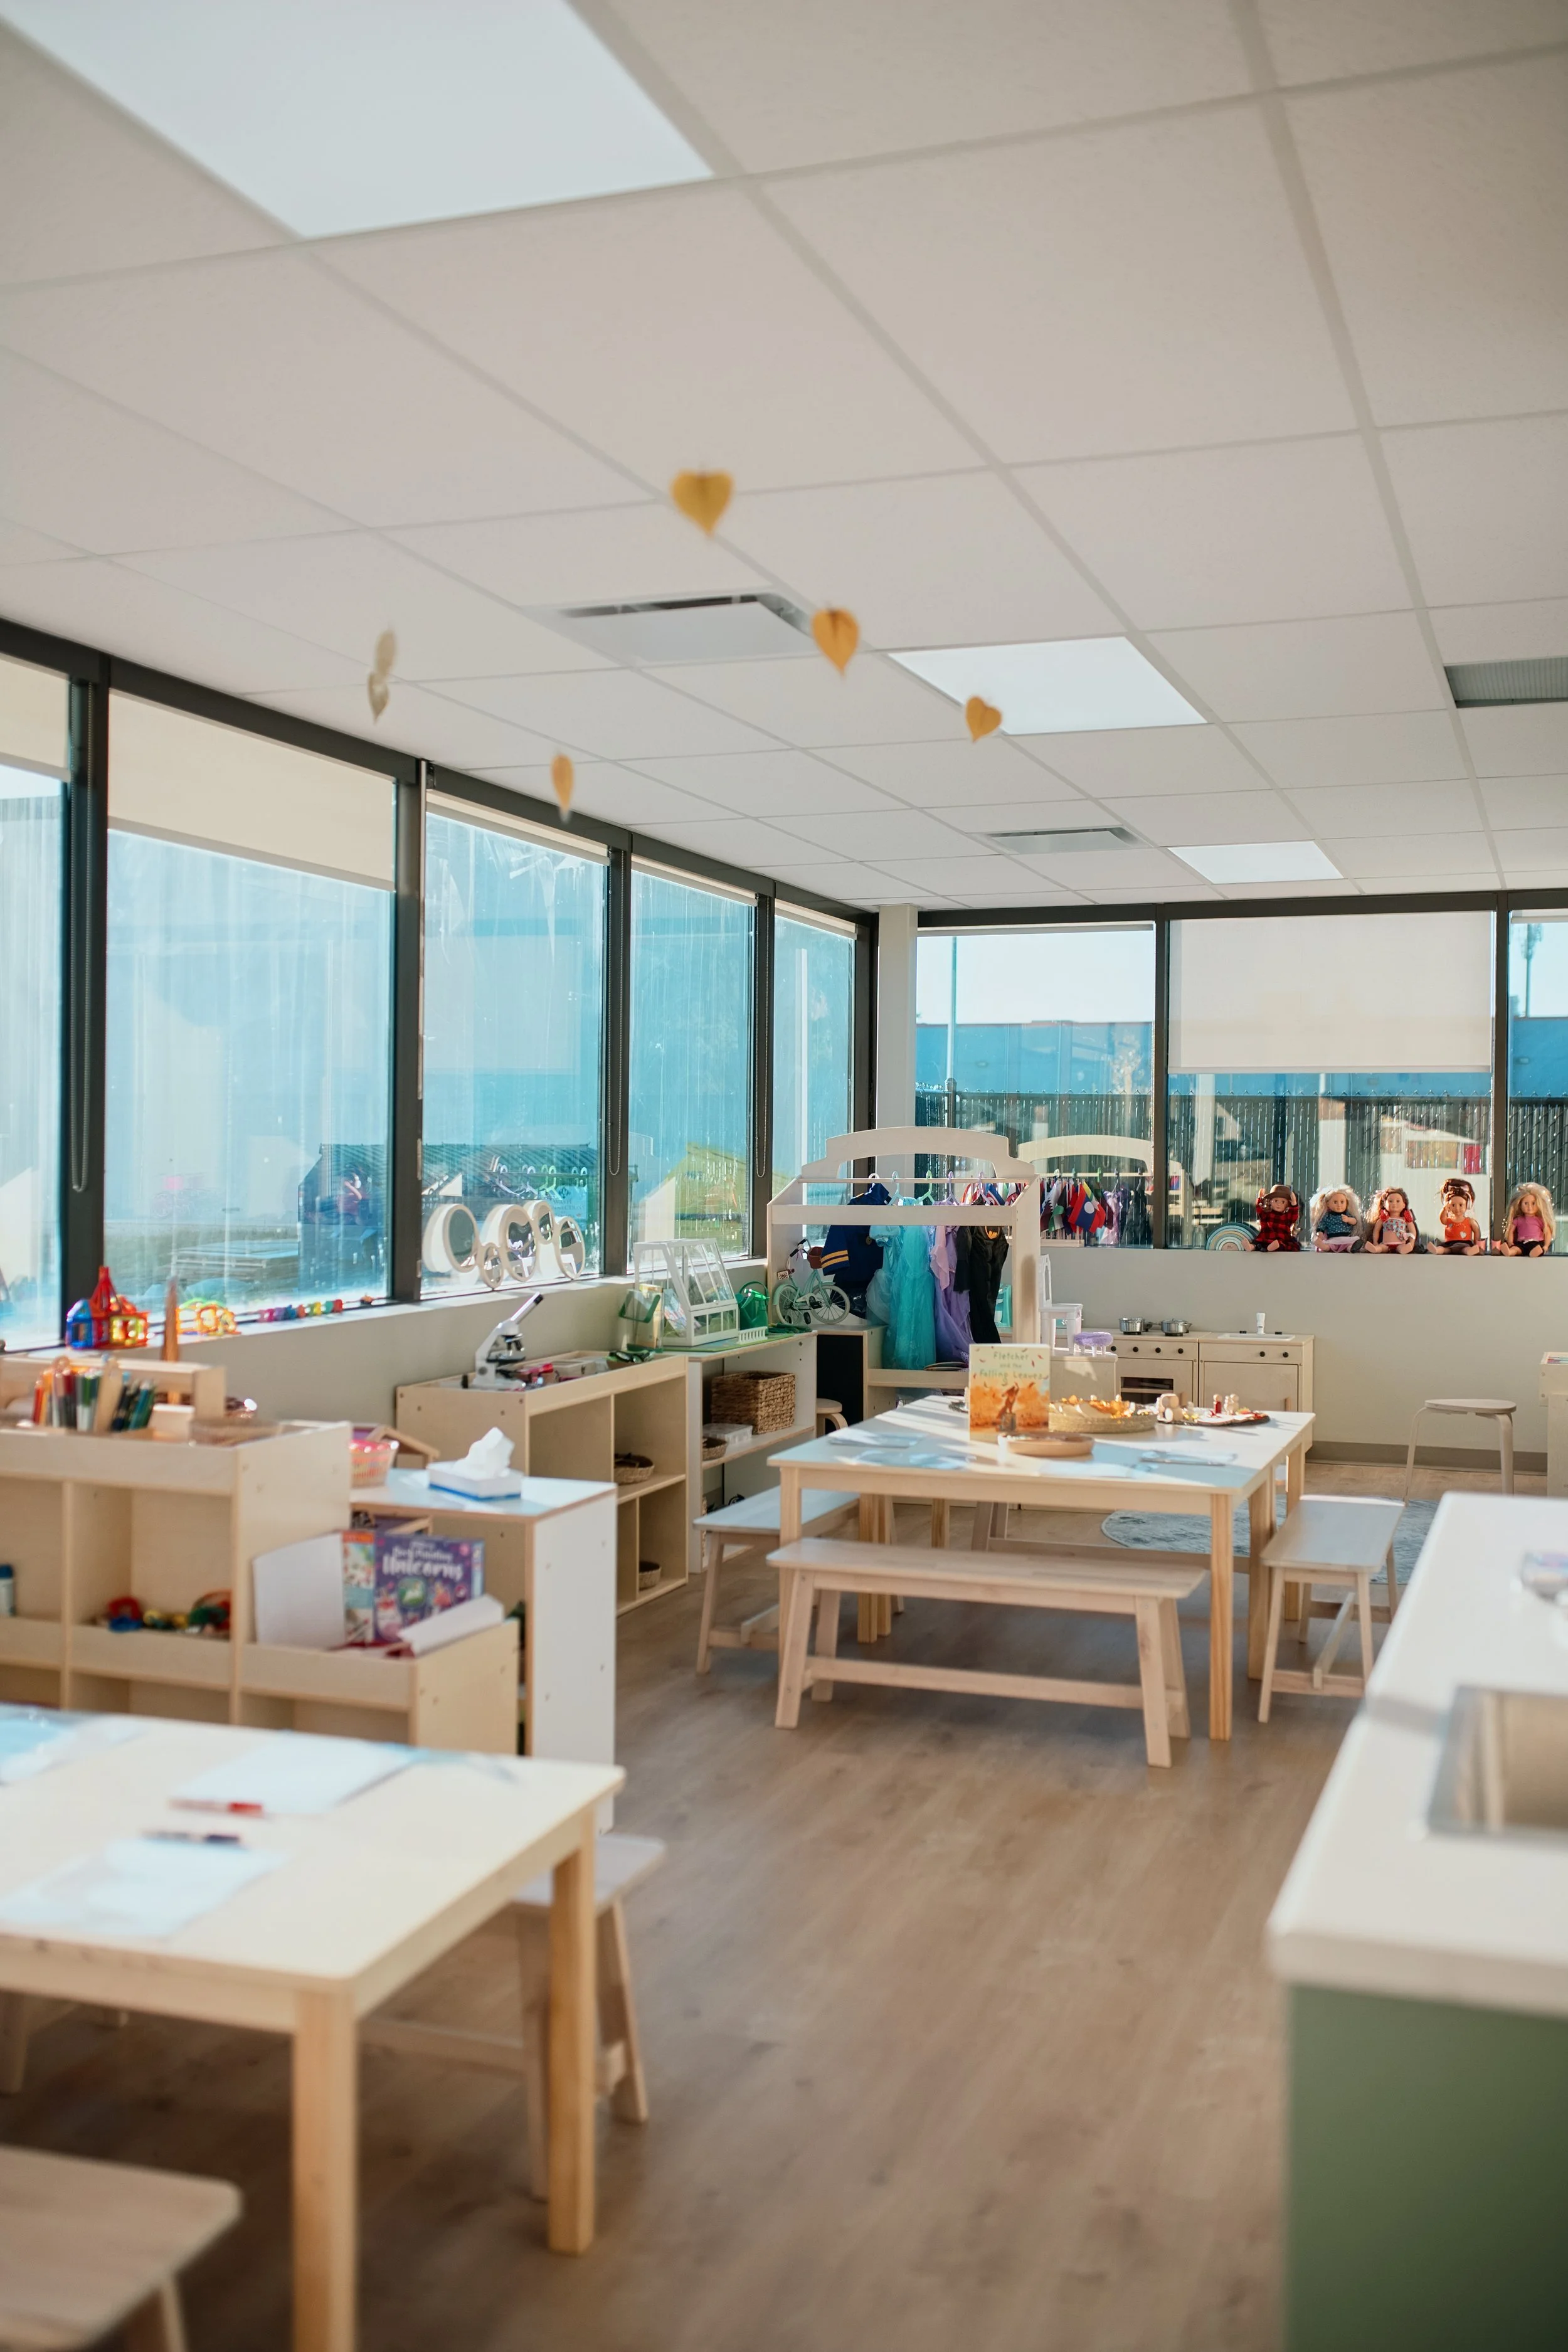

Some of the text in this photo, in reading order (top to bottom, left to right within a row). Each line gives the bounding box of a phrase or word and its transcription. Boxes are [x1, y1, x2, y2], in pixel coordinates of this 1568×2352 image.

[993, 1351, 1029, 1360] Fletcher
[980, 1368, 1042, 1387] Falling Leaves
[383, 1553, 463, 1581] Unicorns
